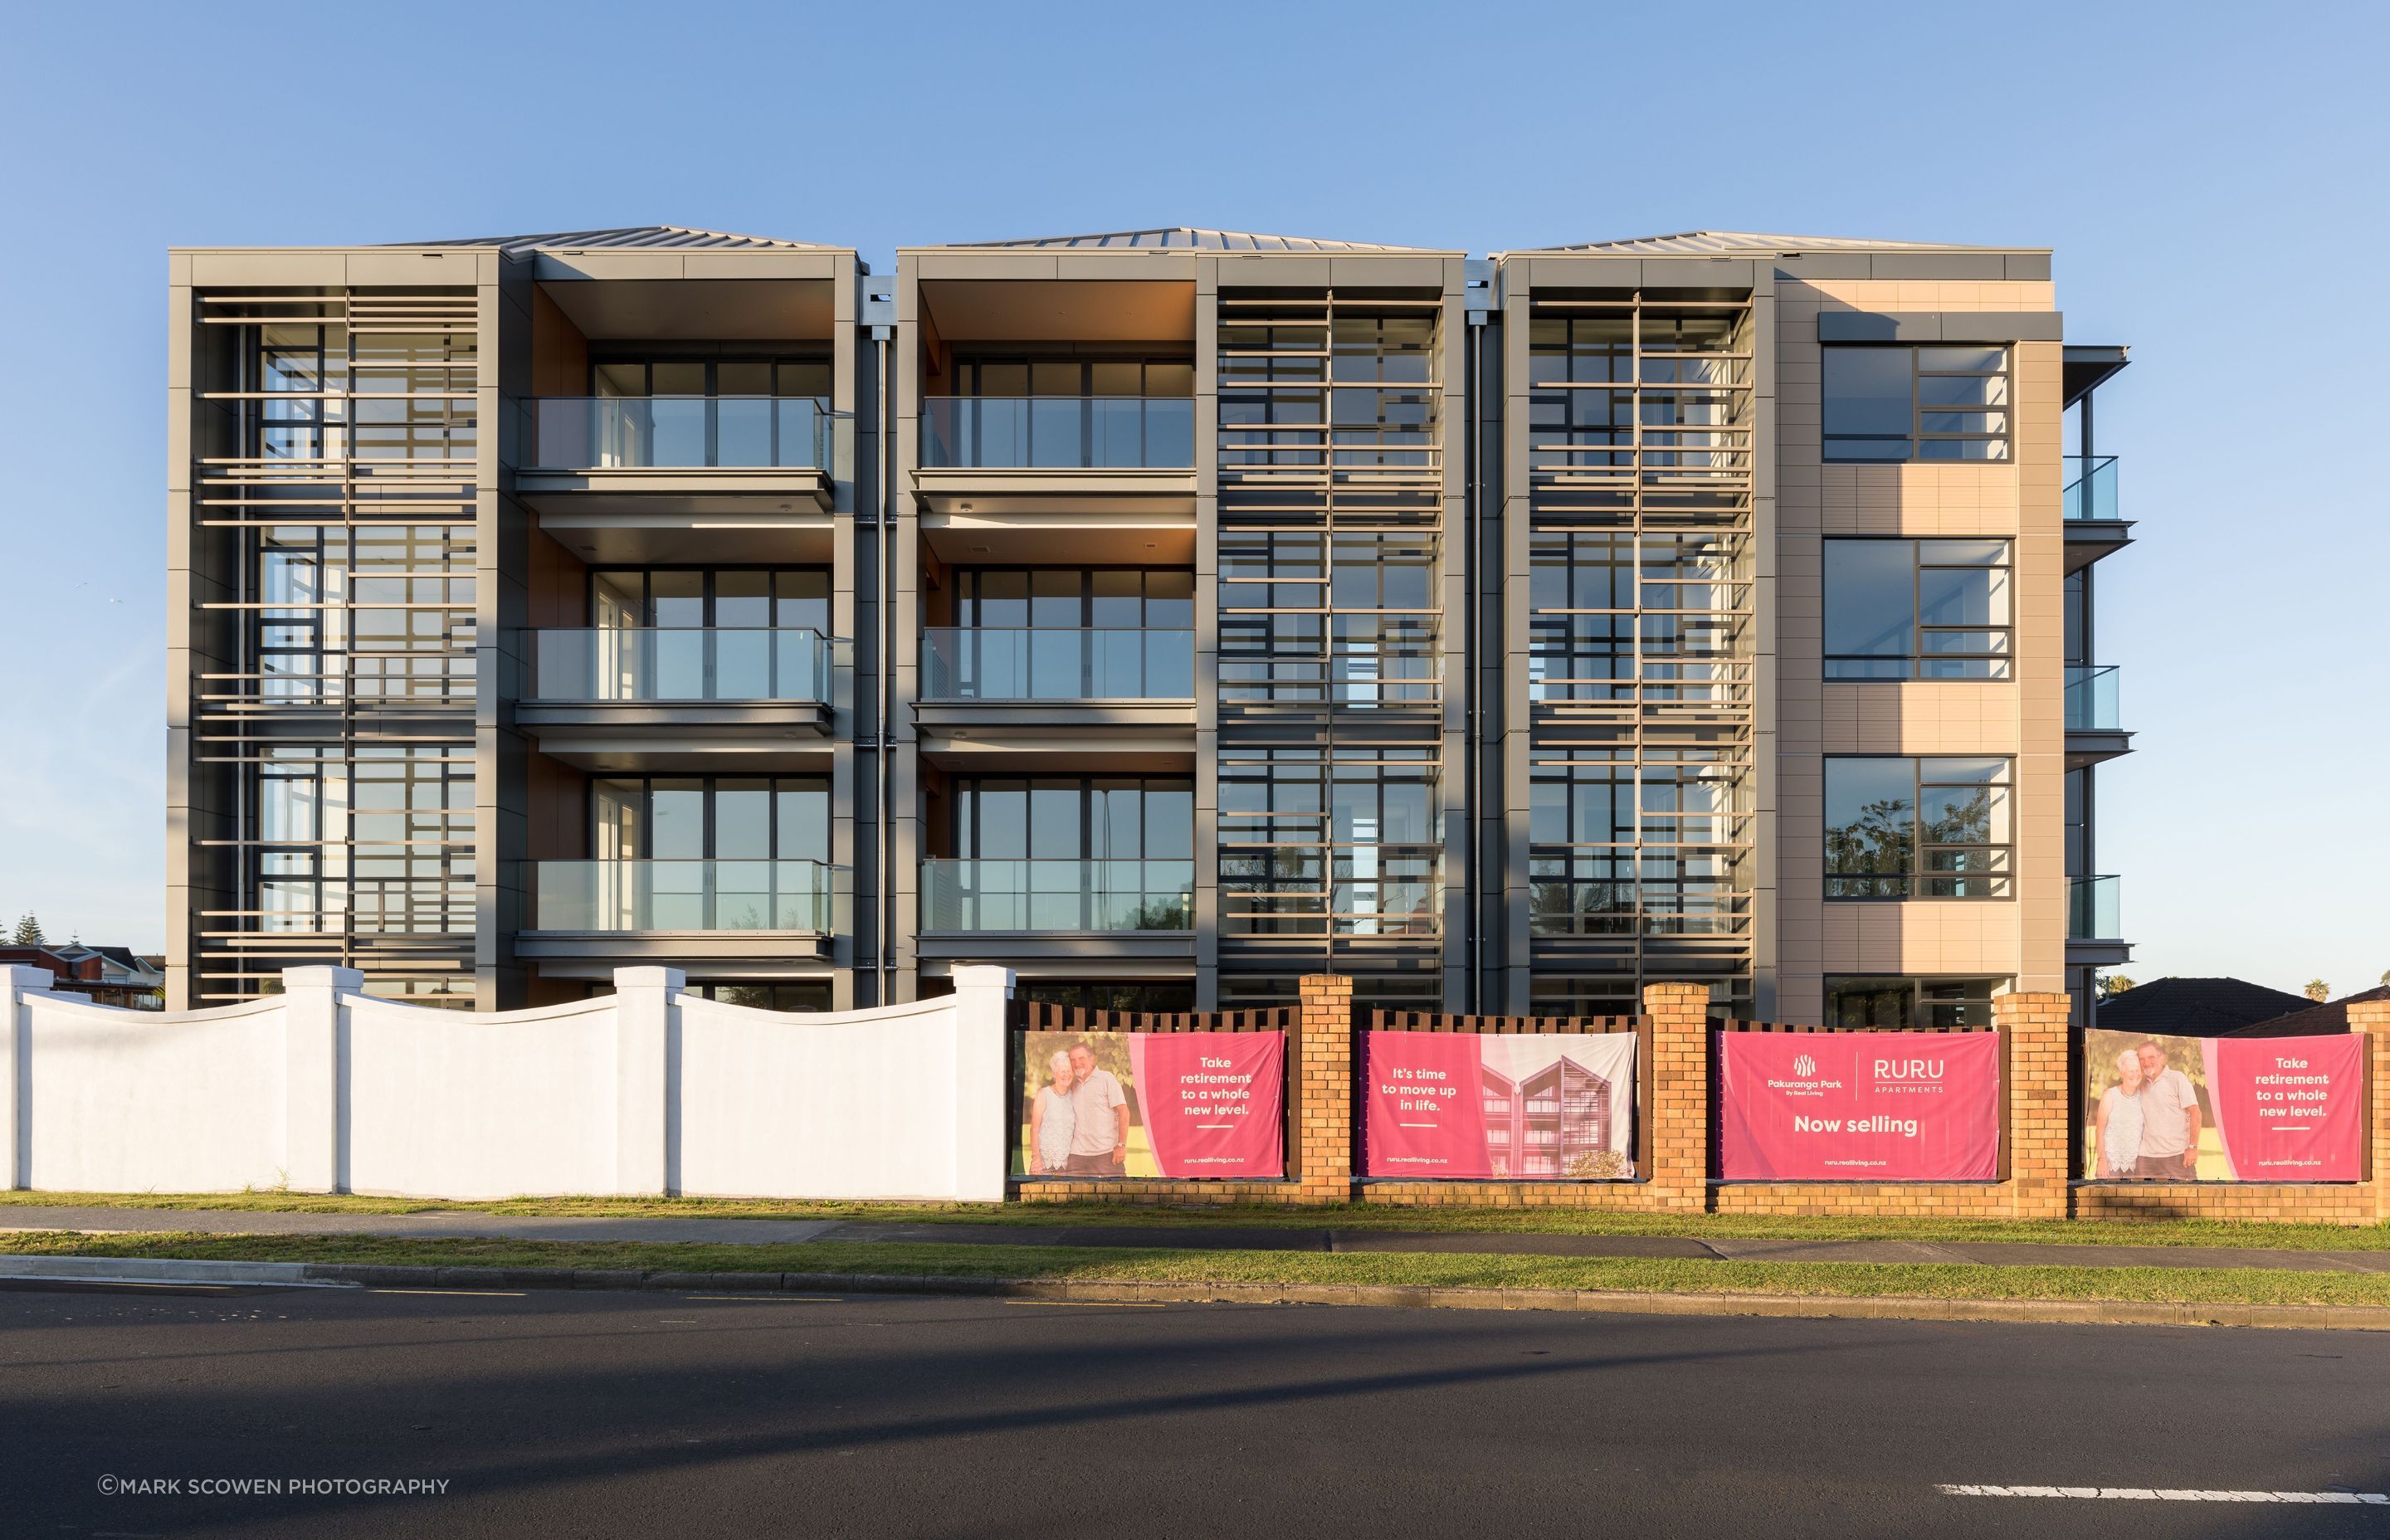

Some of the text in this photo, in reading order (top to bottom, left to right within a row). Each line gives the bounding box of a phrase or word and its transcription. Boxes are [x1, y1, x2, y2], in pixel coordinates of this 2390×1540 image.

[1200, 1056, 1232, 1068] Take
[2275, 1057, 2309, 1069] Take
[1393, 1068, 1446, 1080] It’s time
[1874, 1060, 1944, 1079] RURU
[1181, 1072, 1252, 1084] retirement
[2256, 1073, 2329, 1084] retirement
[1768, 1079, 1842, 1090] Pakuranga Park
[1181, 1088, 1250, 1099] to a whole
[1381, 1084, 1456, 1099] to move up
[2256, 1089, 2328, 1101] to a whole
[1184, 1104, 1249, 1115] new level.
[1400, 1099, 1441, 1112] in life.
[2259, 1105, 2327, 1117] new level.
[1794, 1115, 1918, 1138] Now selling
[1184, 1157, 1245, 1165] ruru.realliving.co.nz
[1387, 1157, 1448, 1165] ruru.realliving.co.nz
[1824, 1159, 1887, 1167] ruru.realliving.co.nz
[2258, 1159, 2322, 1167] ruru.realliving.co.nz
